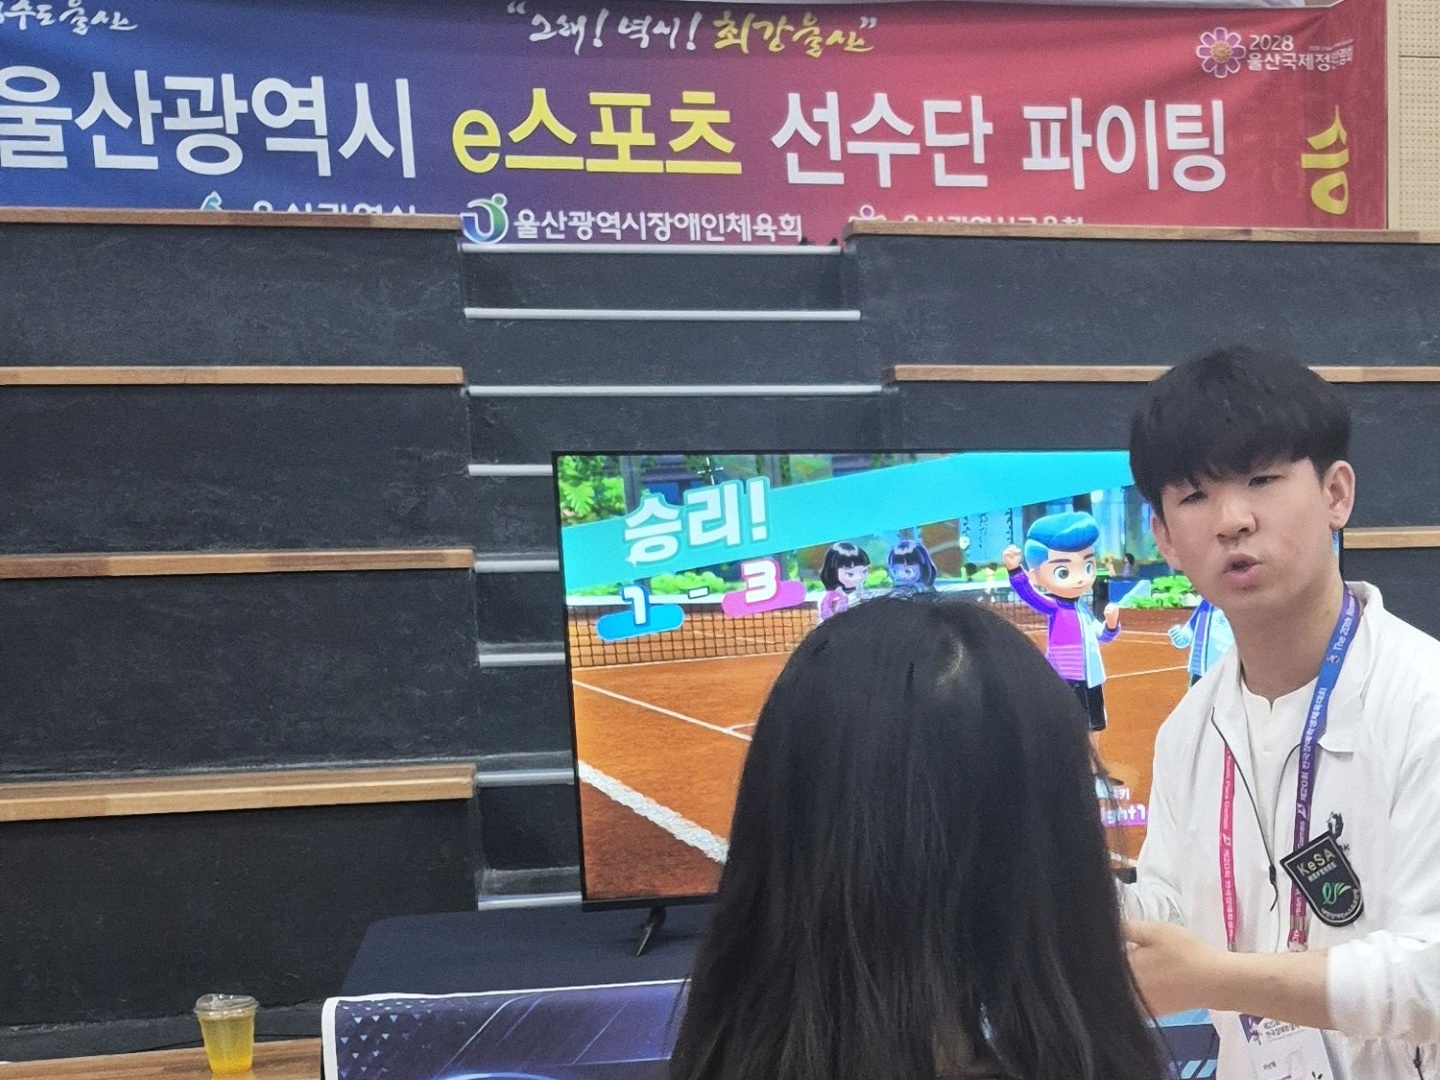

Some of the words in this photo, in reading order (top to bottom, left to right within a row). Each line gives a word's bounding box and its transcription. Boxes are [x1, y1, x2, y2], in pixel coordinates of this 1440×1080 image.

[1249, 35, 1294, 51] 2028
[0, 66, 416, 178] 울산광역시
[452, 88, 742, 175] e스포츠
[771, 92, 993, 189] 선수단
[1021, 98, 1226, 191] 파이팅
[513, 208, 803, 242] 울산광역시장애인체육회
[624, 479, 768, 567] 승리!
[623, 586, 647, 625] 1
[743, 560, 778, 604] 3
[1297, 848, 1336, 877] KeSA
